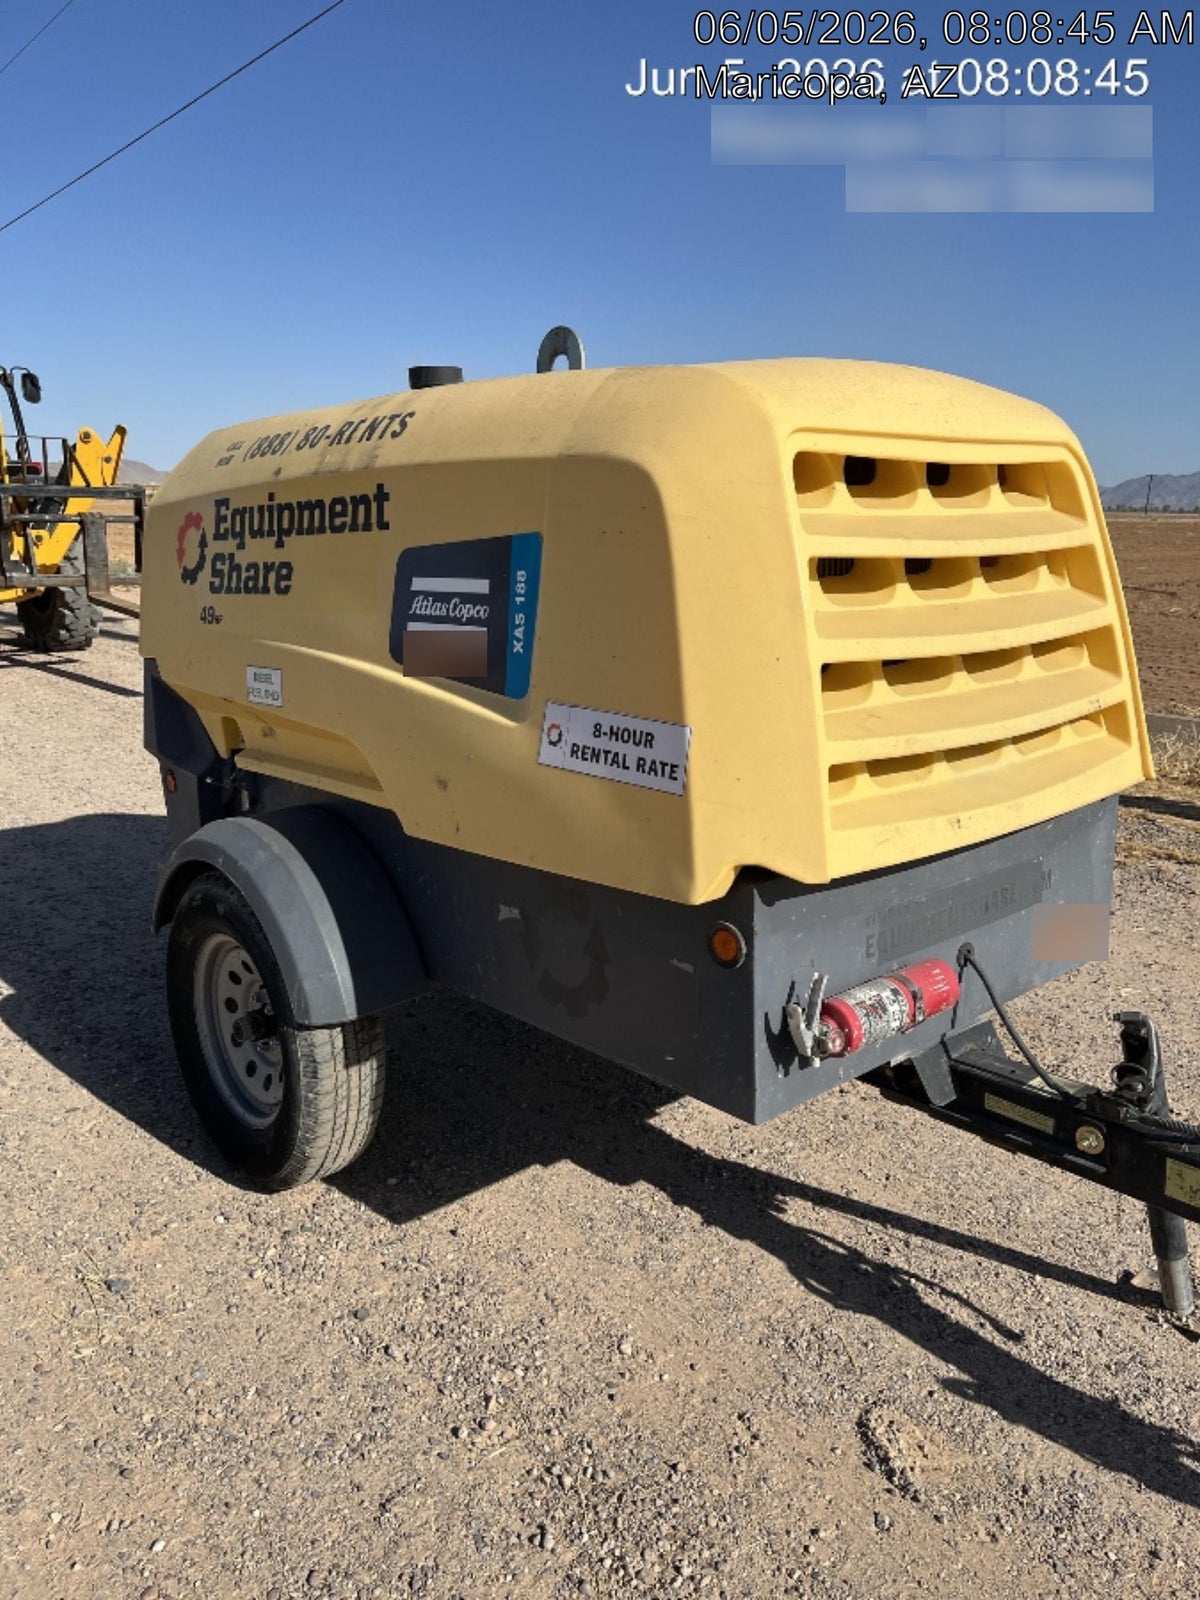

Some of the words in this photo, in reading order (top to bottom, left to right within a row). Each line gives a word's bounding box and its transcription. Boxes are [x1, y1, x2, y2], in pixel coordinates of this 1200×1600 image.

[242, 429, 300, 463] (888)
[295, 410, 417, 452] 80-RENTS
[212, 482, 391, 550] Equipment
[209, 552, 294, 596] Share
[515, 569, 528, 605] 188
[513, 613, 527, 654] XAS
[592, 722, 656, 750] 8-HOUR
[569, 742, 630, 771] RENTAL
[635, 756, 680, 782] RATE
